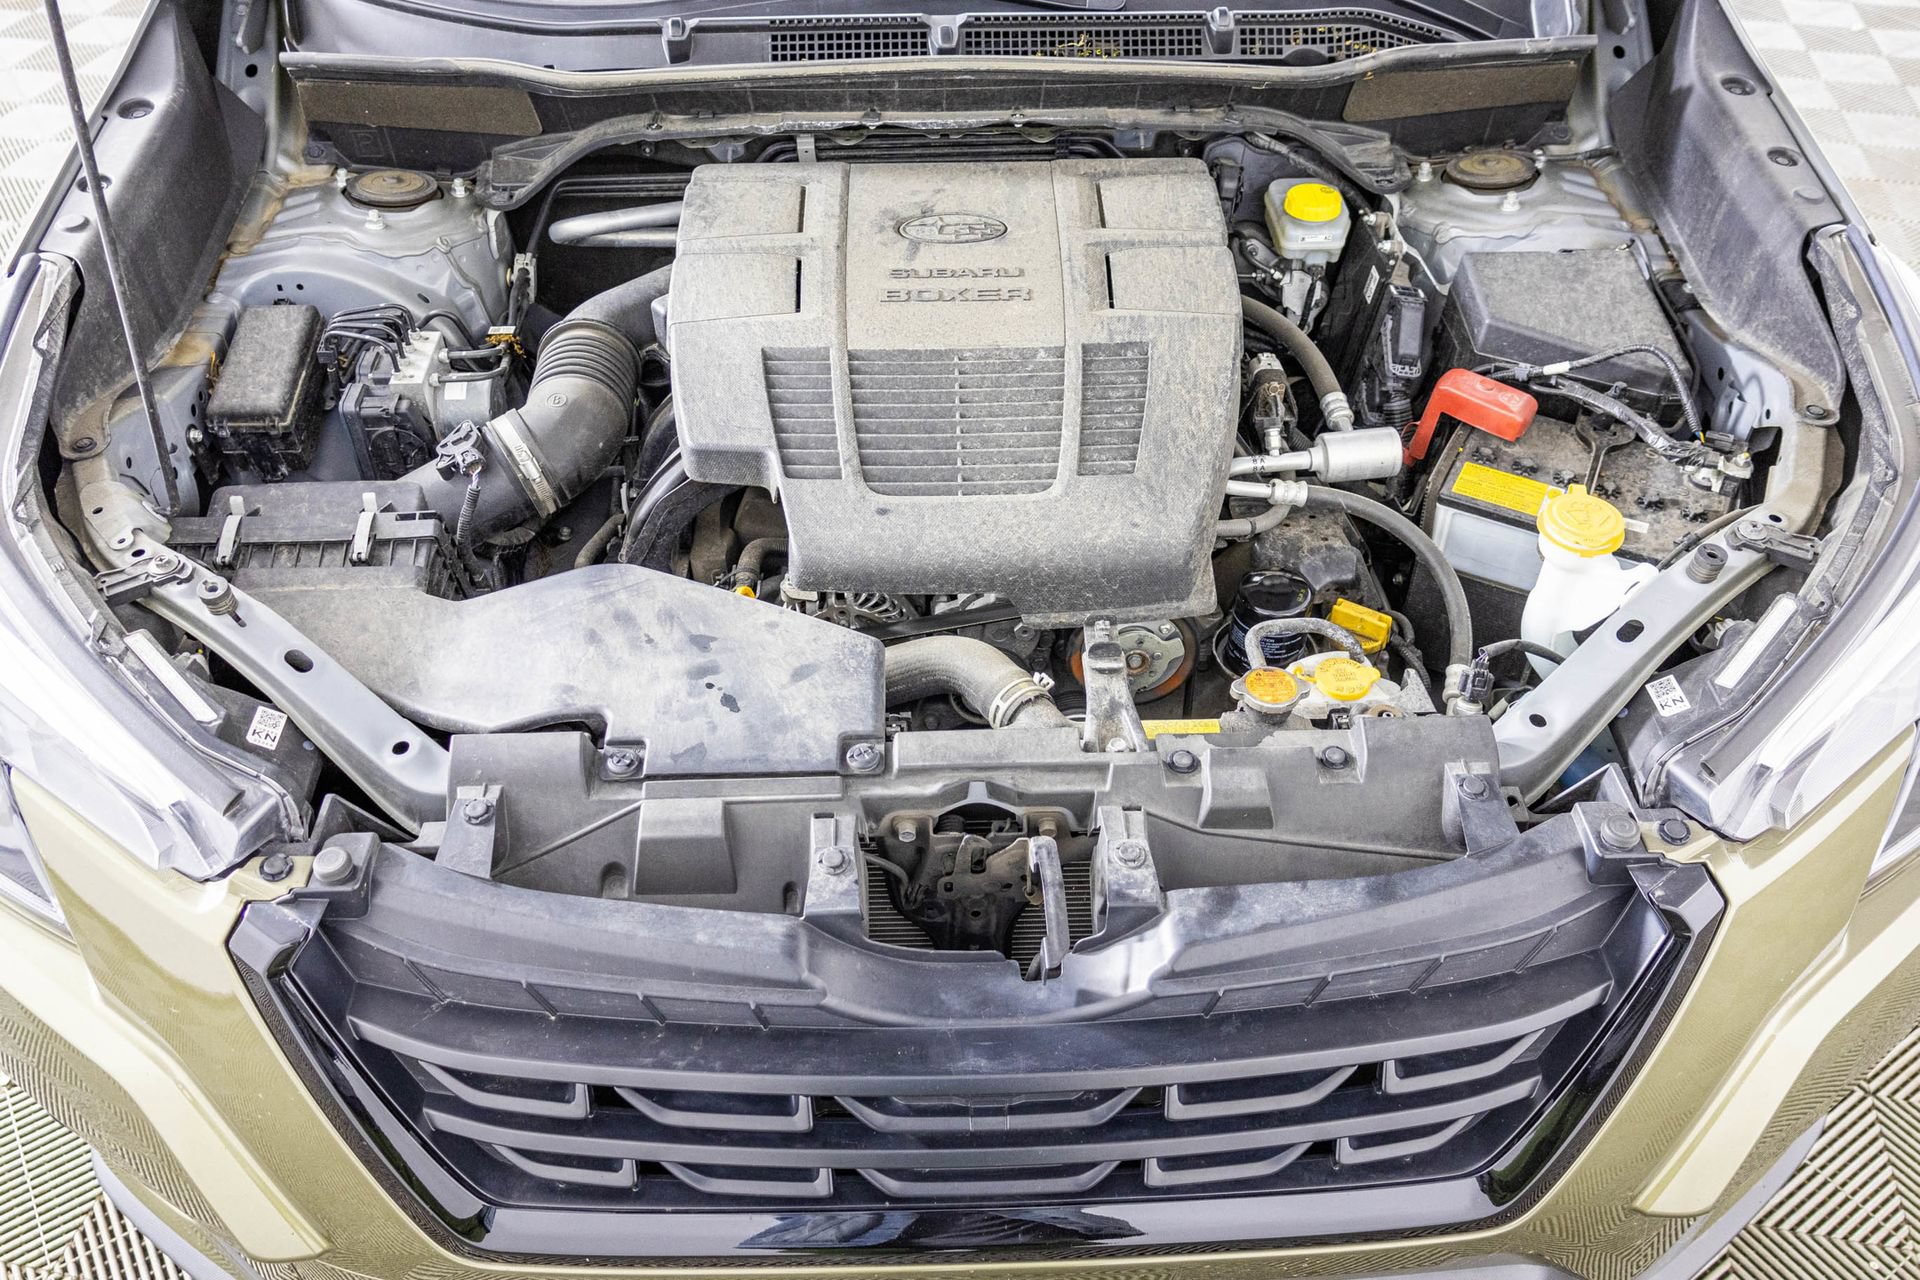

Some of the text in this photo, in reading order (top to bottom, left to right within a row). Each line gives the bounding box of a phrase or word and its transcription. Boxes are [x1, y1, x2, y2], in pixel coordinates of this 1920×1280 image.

[889, 267, 1026, 279] SUBARU
[880, 287, 1033, 303] BOXER
[1660, 695, 1685, 711] KN
[251, 728, 277, 743] KN
